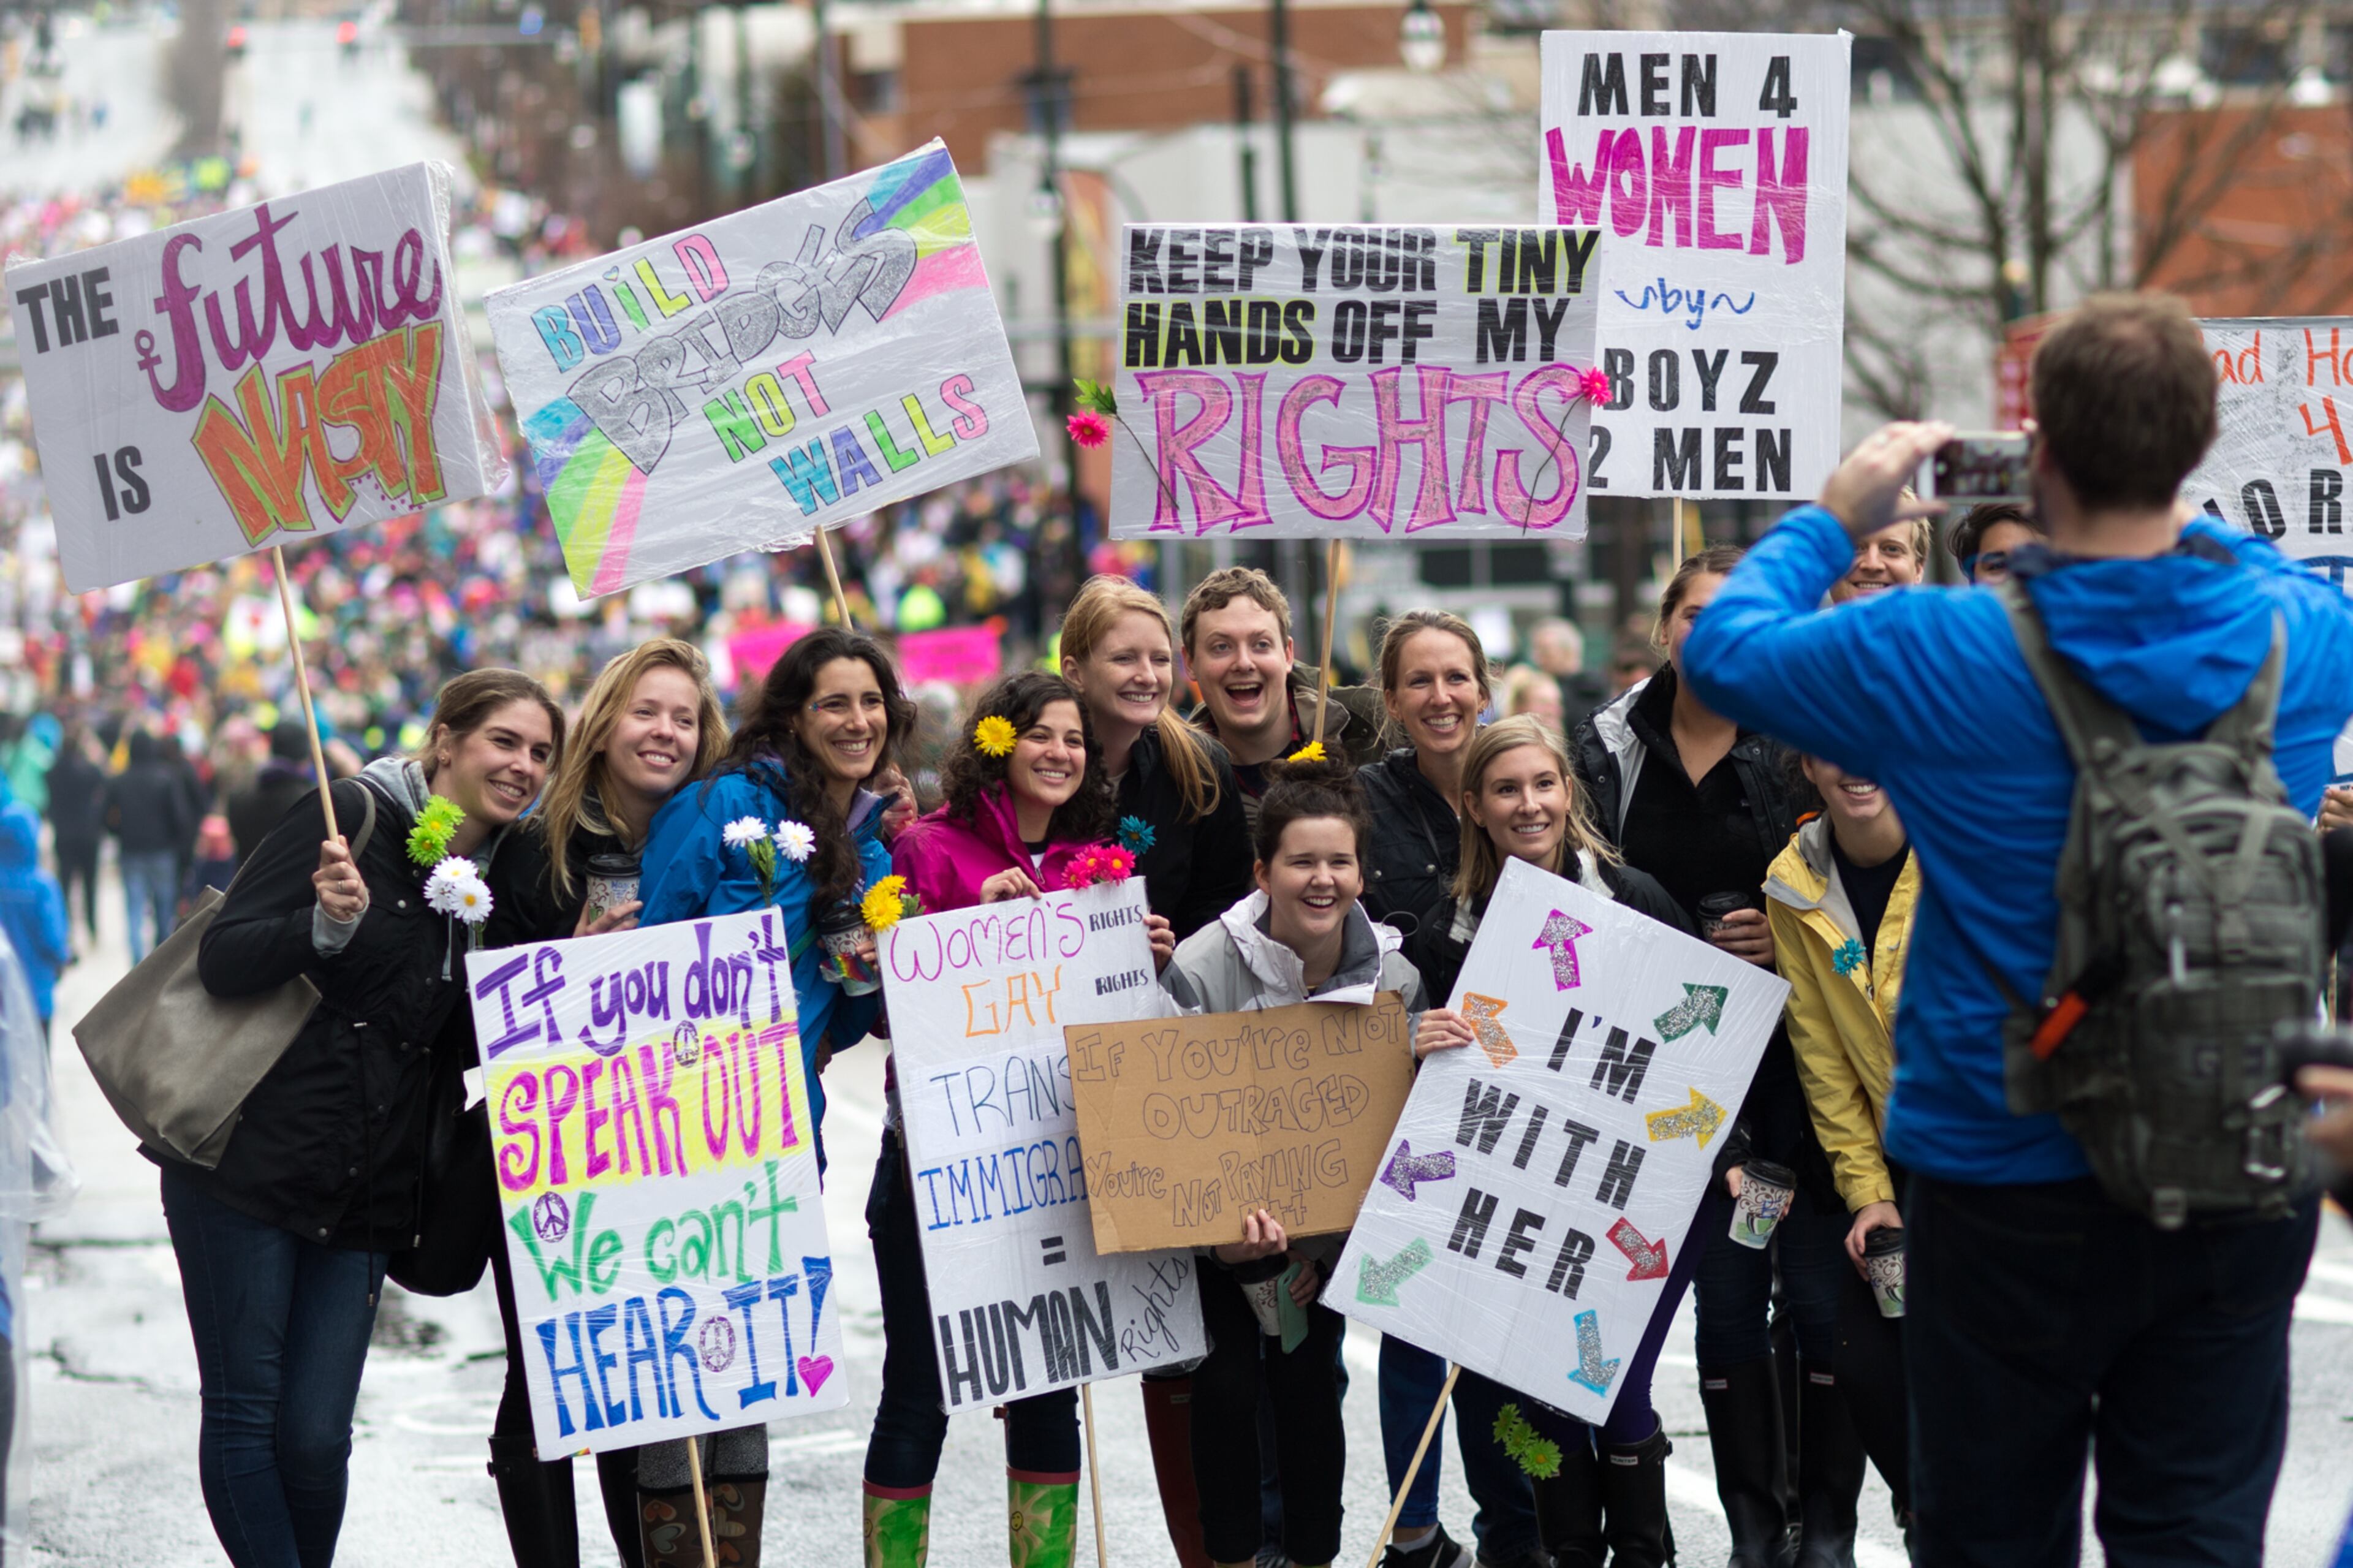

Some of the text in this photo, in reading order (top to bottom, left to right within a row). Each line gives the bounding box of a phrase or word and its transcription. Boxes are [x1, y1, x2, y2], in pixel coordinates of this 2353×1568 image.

[1578, 53, 1798, 118] MEN 4
[1545, 126, 1809, 265] WOMEN
[17, 203, 443, 412] THE future
[531, 234, 729, 374] BUiLD
[1129, 226, 1600, 294] KEEP YOUR TINY
[566, 197, 917, 475] BRIDGES
[1124, 297, 1570, 368] HANDS OFF MY
[1604, 348, 1779, 415] BOYZ
[191, 320, 447, 548] NASTY
[702, 350, 830, 463] NOT
[768, 374, 988, 515] WALLS
[1134, 363, 1587, 536] RIGHTS
[1587, 425, 1792, 492] 2 MEN
[94, 446, 151, 521] IS
[1089, 904, 1143, 931] RIGHTS
[476, 914, 786, 1059] If you don't
[962, 964, 1149, 1039] GAY RIGHTS
[499, 1021, 799, 1192] SPEAK OUT
[1076, 1032, 1125, 1081] IF
[1143, 1074, 1368, 1139] OUTRAGED
[1547, 1007, 1656, 1104] I'M
[1086, 1151, 1166, 1199] You're
[1219, 1139, 1347, 1202] PAYING
[1455, 1078, 1646, 1211] WITH
[507, 1161, 799, 1303] We can't
[1447, 1187, 1596, 1301] HER
[536, 1286, 720, 1438] HEAR
[938, 1255, 1189, 1406] HUMAN Rights
